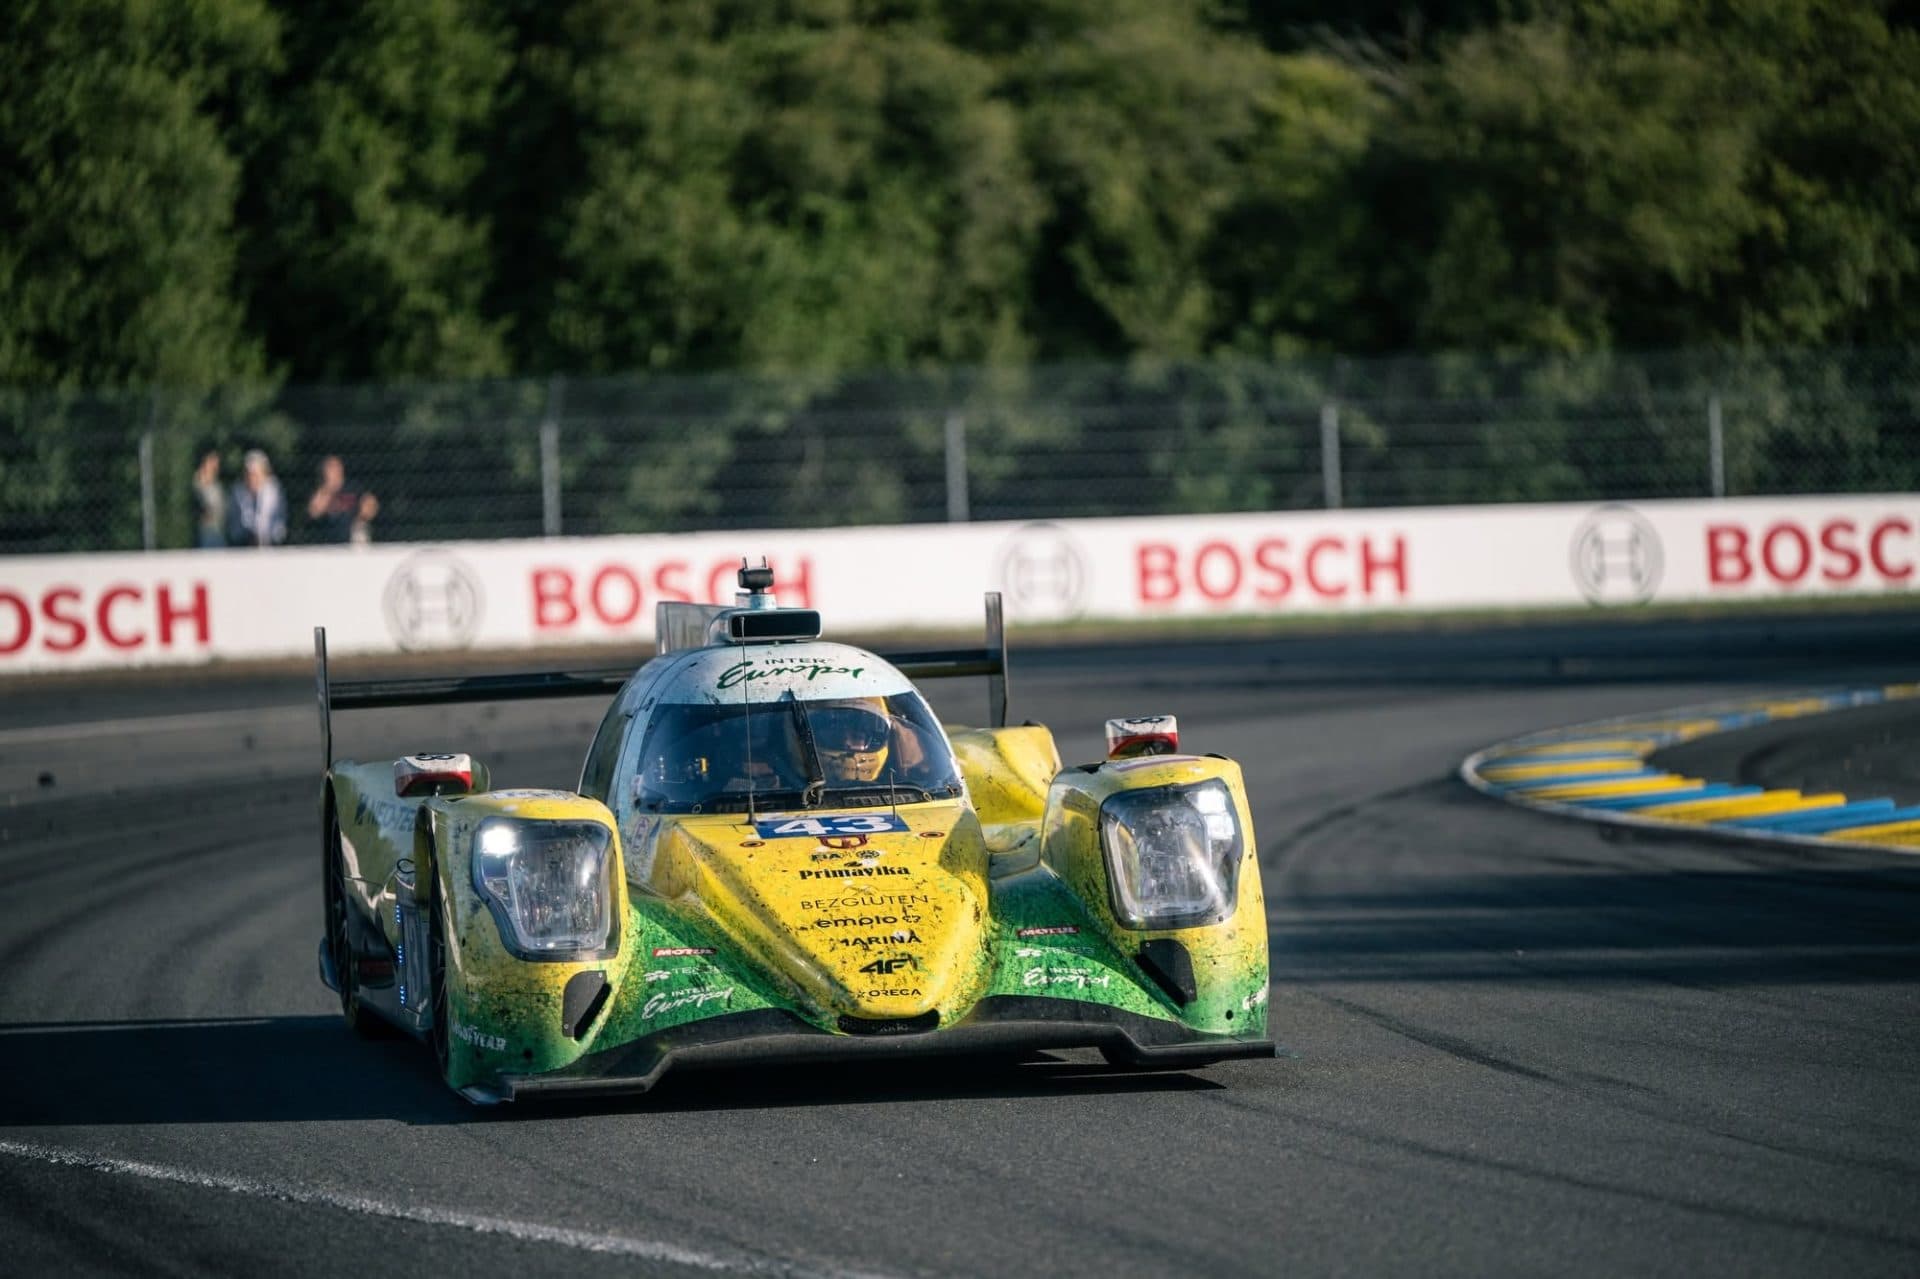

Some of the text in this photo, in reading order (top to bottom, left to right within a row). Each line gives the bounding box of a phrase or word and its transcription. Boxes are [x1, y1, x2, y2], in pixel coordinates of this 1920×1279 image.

[1137, 536, 1408, 603] BOSCH
[765, 657, 827, 665] INTER
[773, 816, 894, 835] 43
[799, 865, 911, 880] Primavika
[801, 894, 929, 910] BEZGLUTEN
[859, 957, 909, 975] 4F
[868, 988, 922, 997] ORECA
